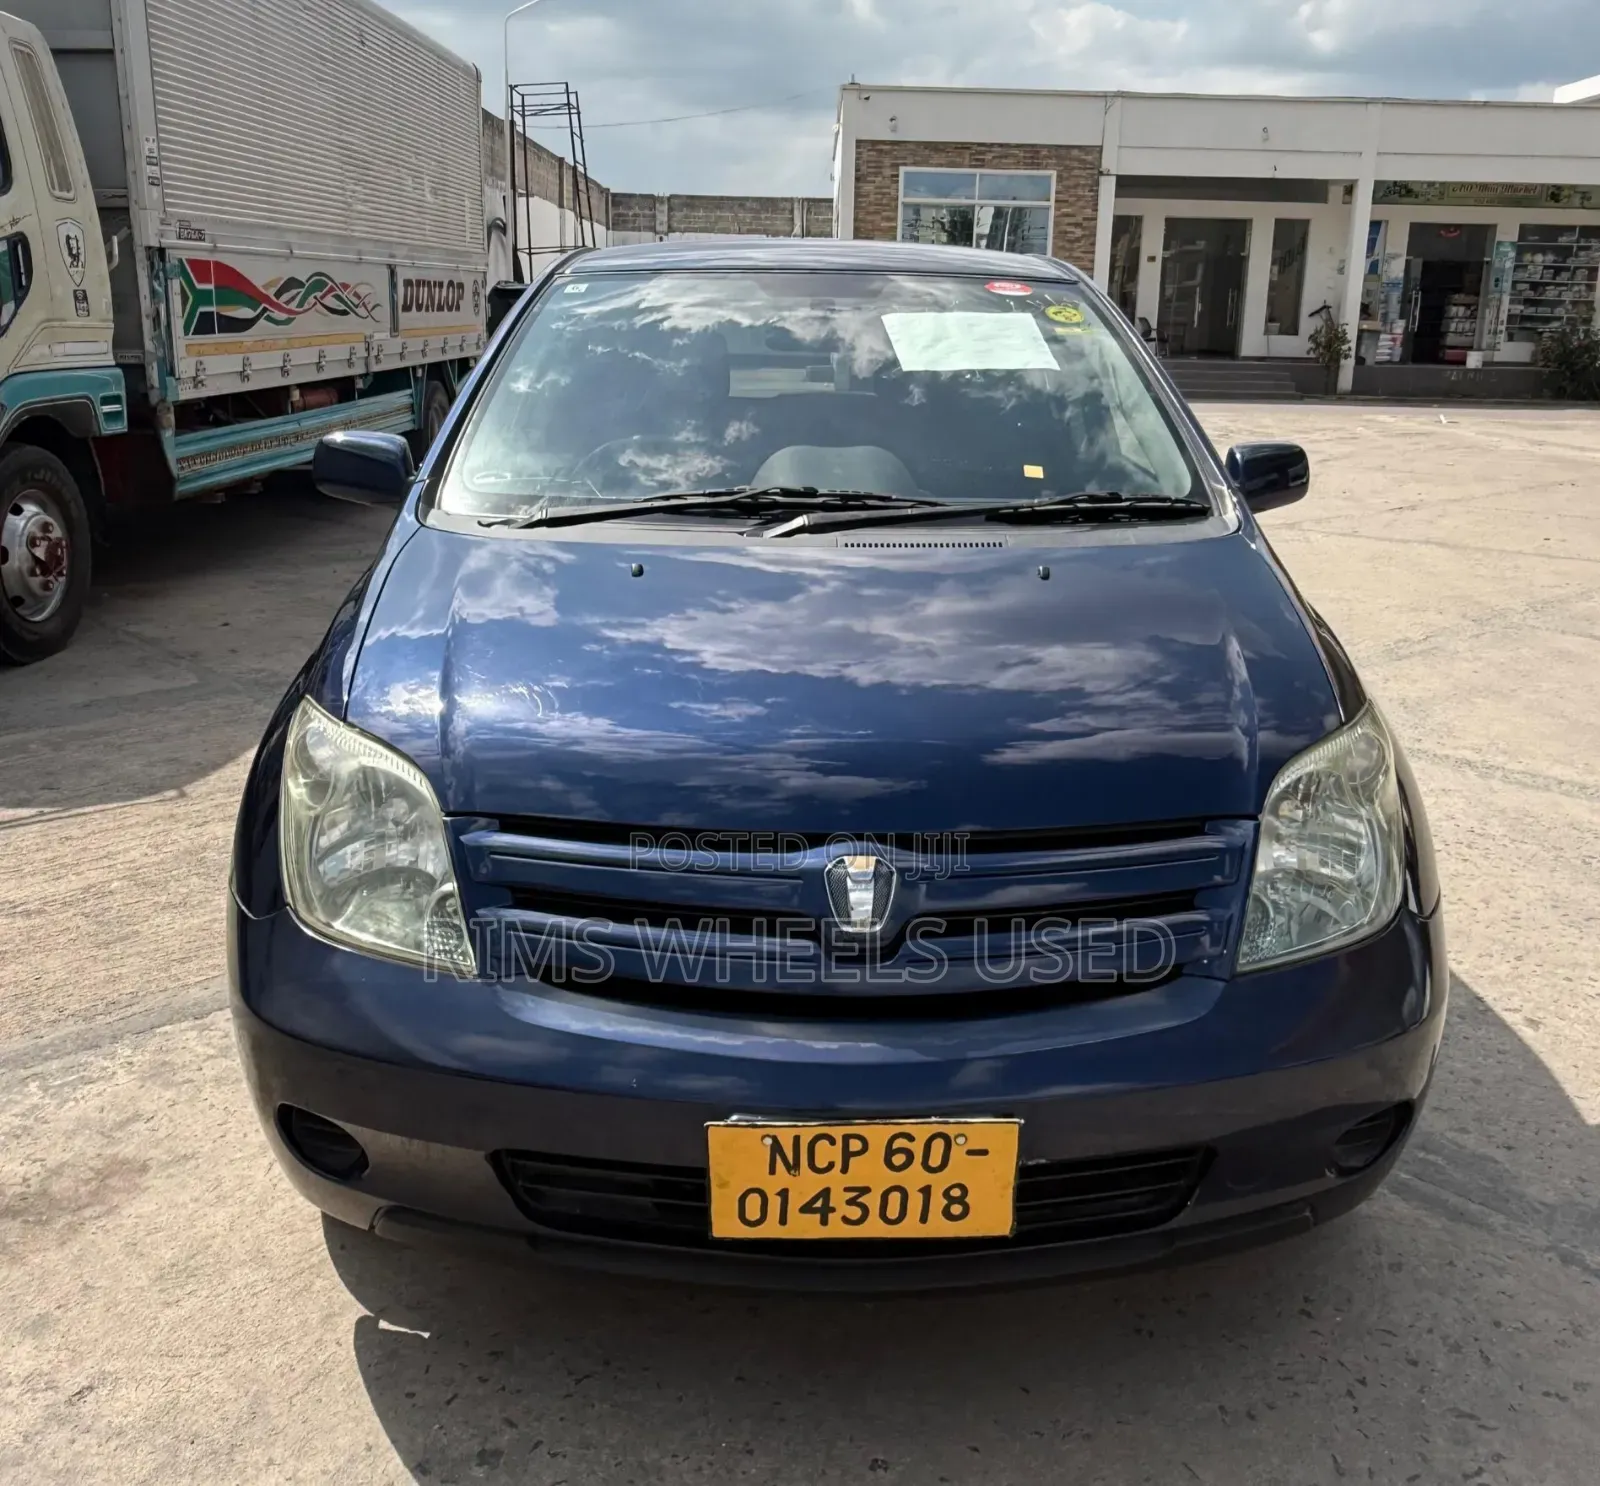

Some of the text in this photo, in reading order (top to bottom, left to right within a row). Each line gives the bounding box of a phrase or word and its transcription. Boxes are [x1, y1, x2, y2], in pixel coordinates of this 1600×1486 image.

[401, 278, 464, 312] DUNLOP
[768, 1134, 869, 1176] NCP
[737, 1183, 970, 1228] 0143018
